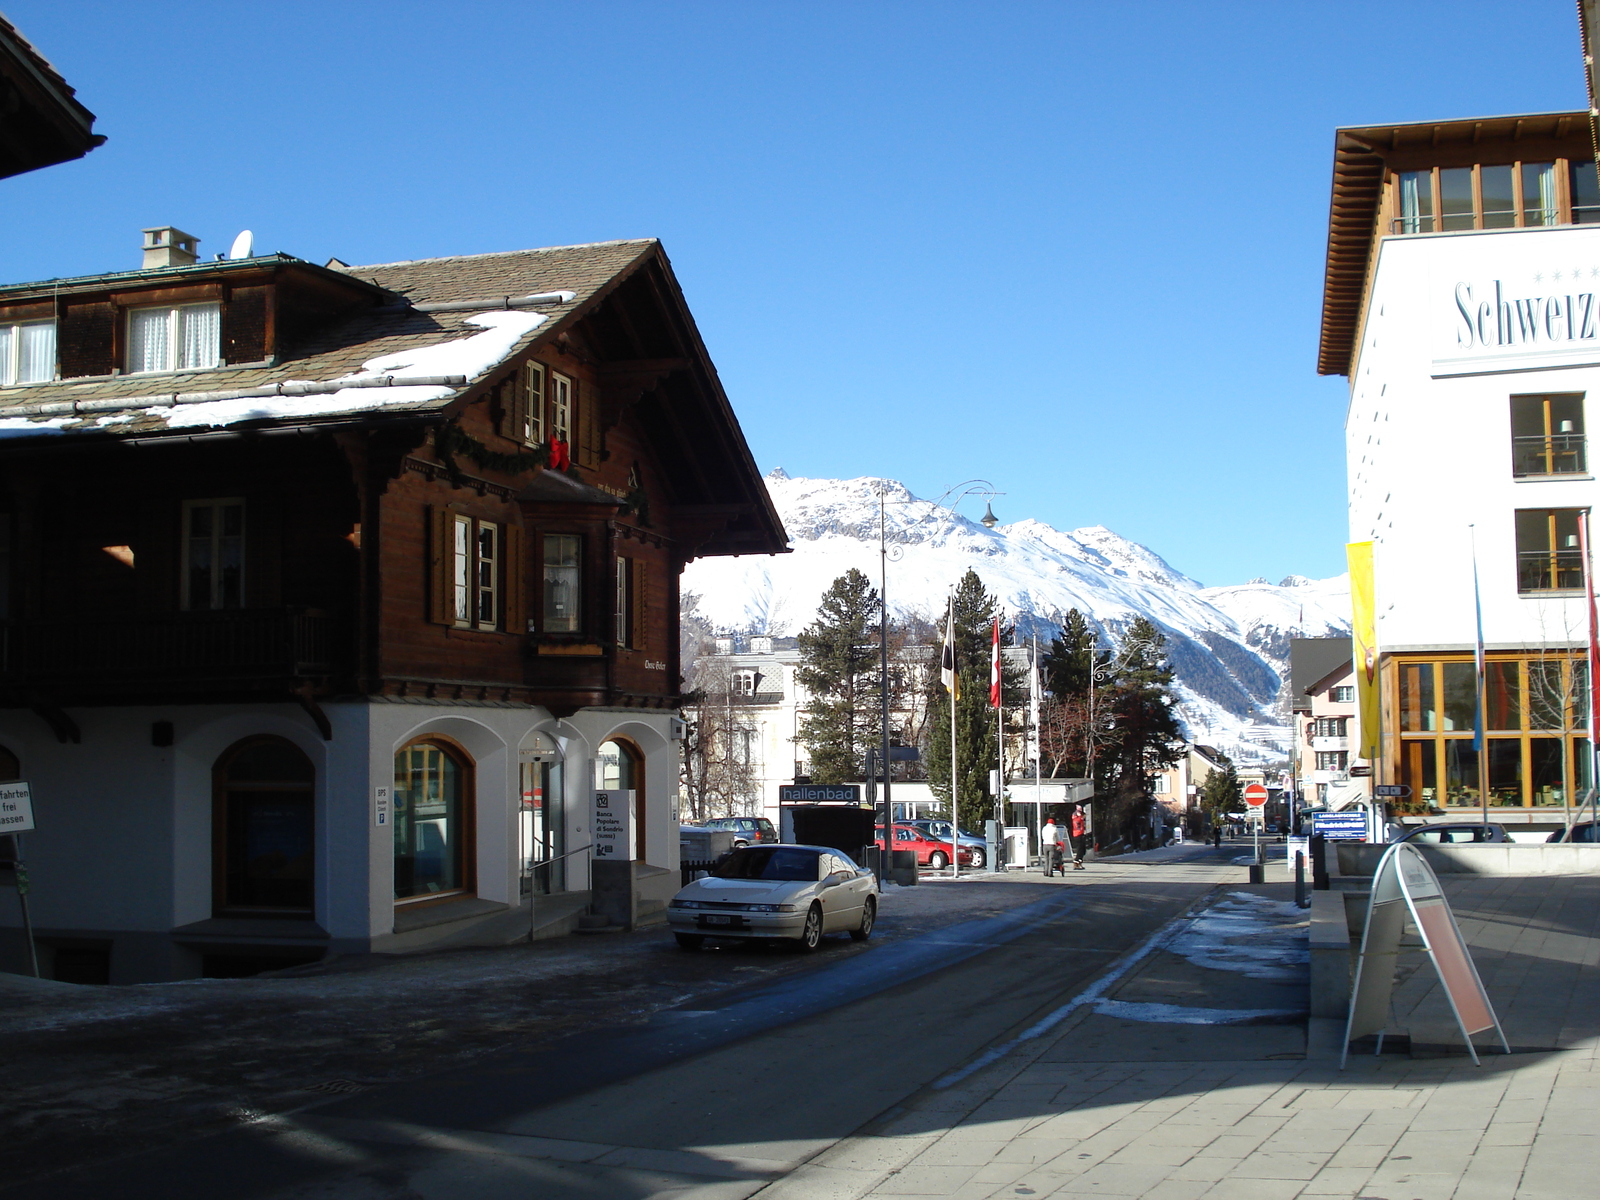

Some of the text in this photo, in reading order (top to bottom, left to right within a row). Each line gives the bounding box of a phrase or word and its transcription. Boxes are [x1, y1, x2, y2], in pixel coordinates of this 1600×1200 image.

[1455, 280, 1600, 350] Schweiz
[377, 788, 386, 797] BPS
[783, 787, 853, 800] hallenbad
[2, 802, 17, 812] frei
[0, 815, 24, 825] assen
